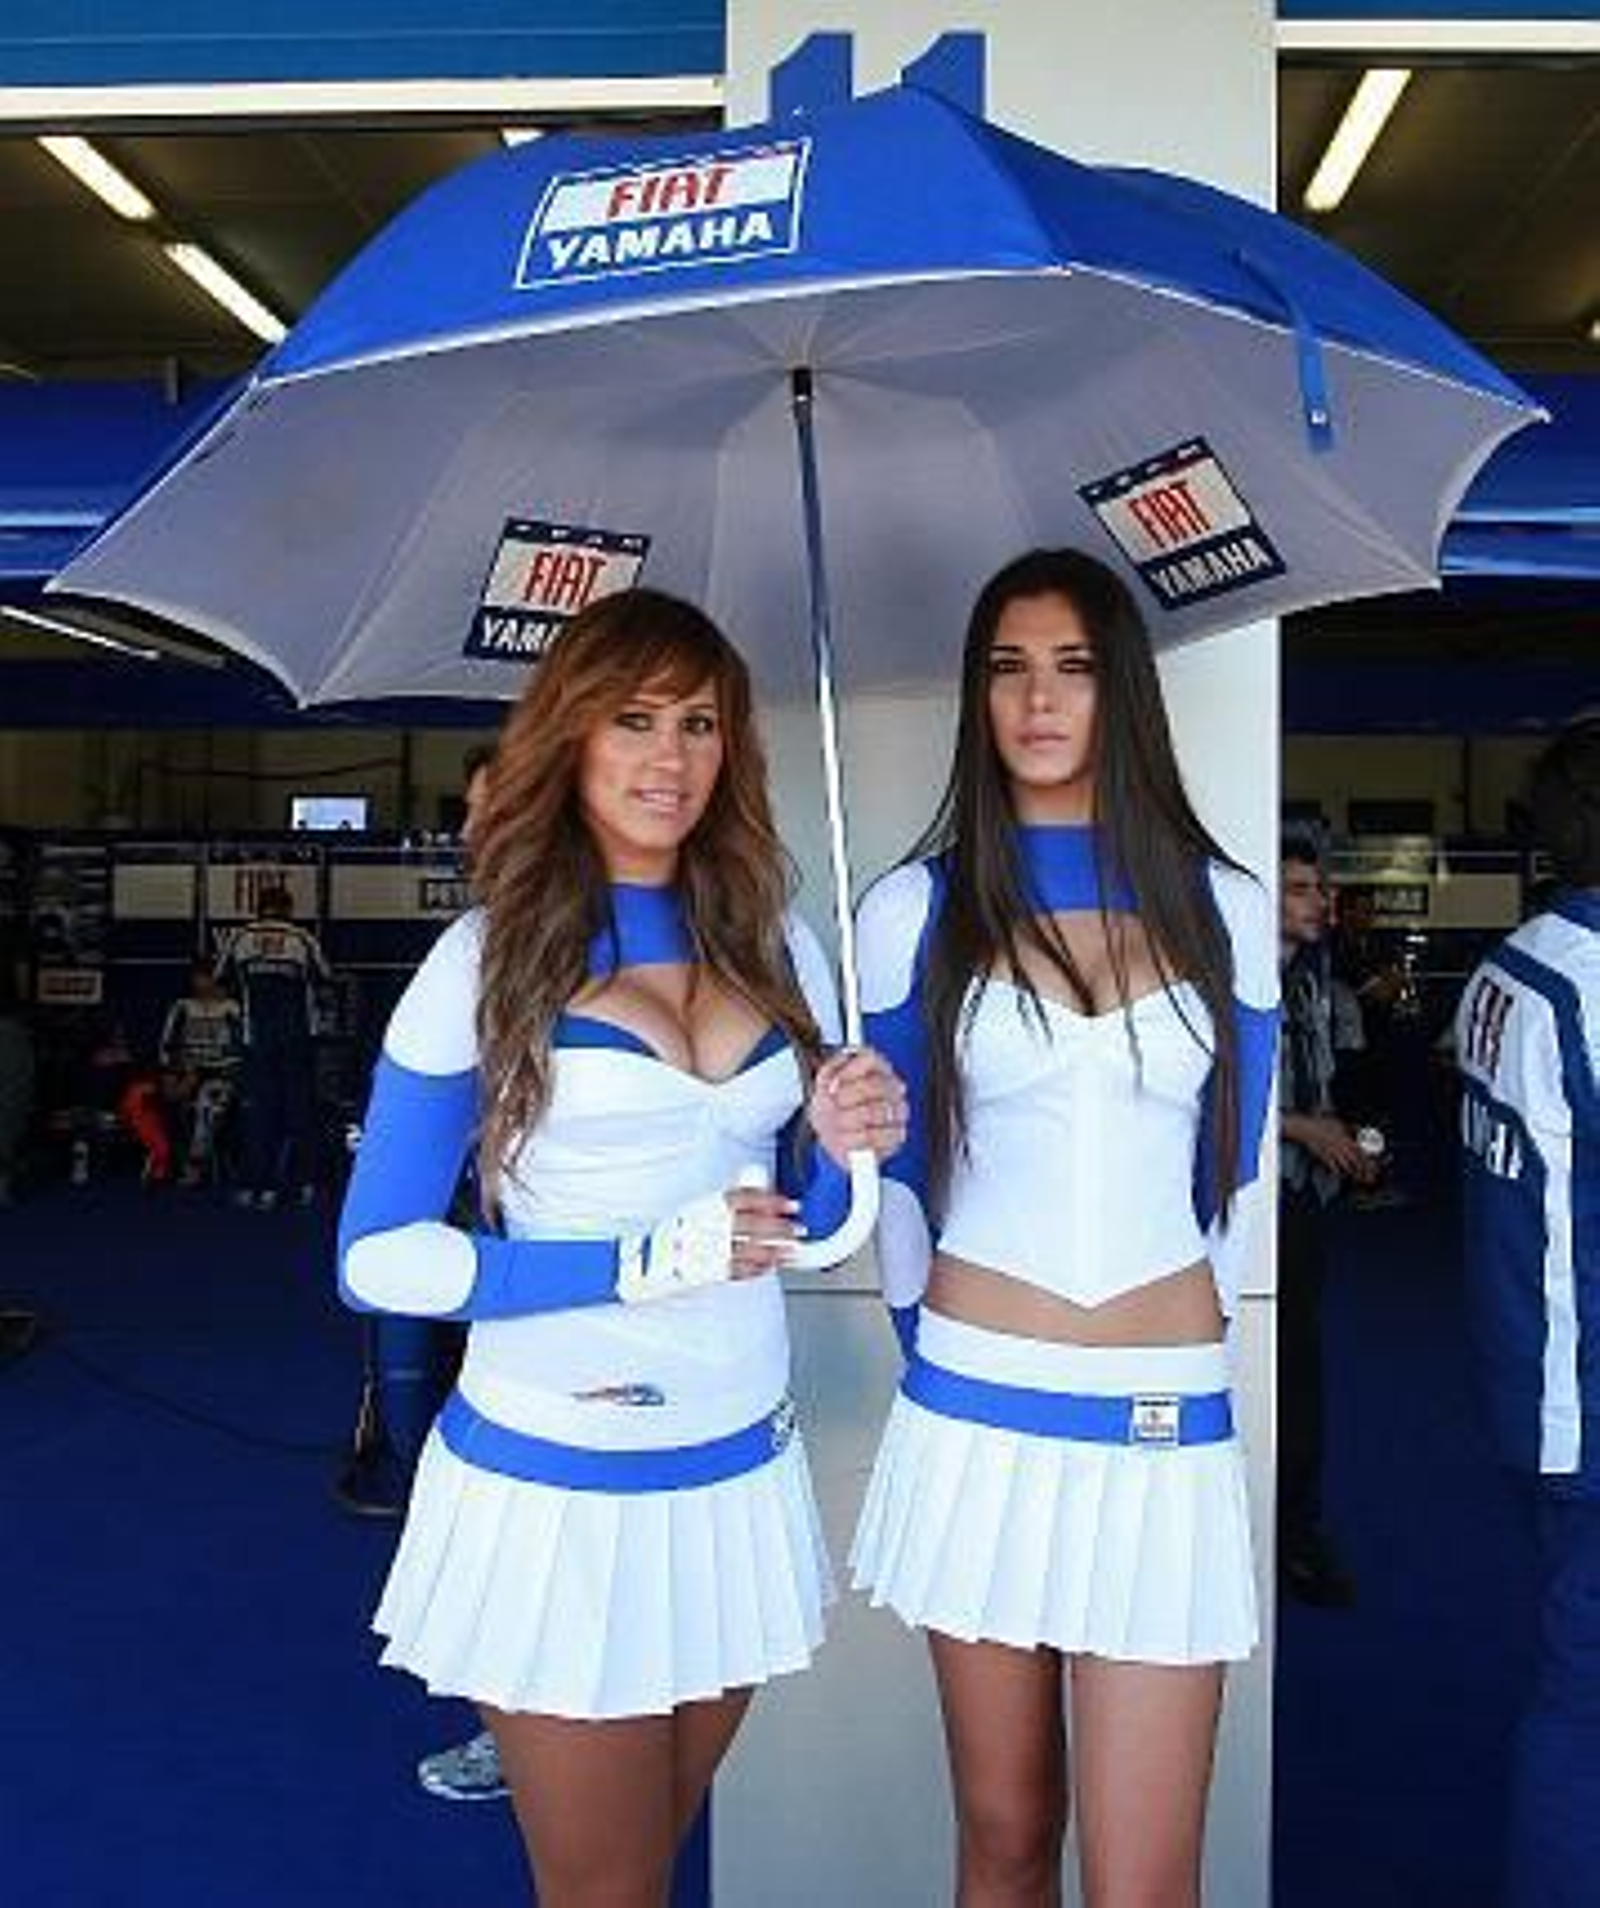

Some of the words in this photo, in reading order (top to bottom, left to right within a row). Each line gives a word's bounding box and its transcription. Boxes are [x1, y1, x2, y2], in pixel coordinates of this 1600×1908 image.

[606, 166, 736, 219] FIAT
[546, 211, 774, 272] YAMAHA
[1128, 480, 1211, 549] FIAT
[524, 551, 606, 609] FIAT
[1150, 537, 1274, 598] YAMAHA
